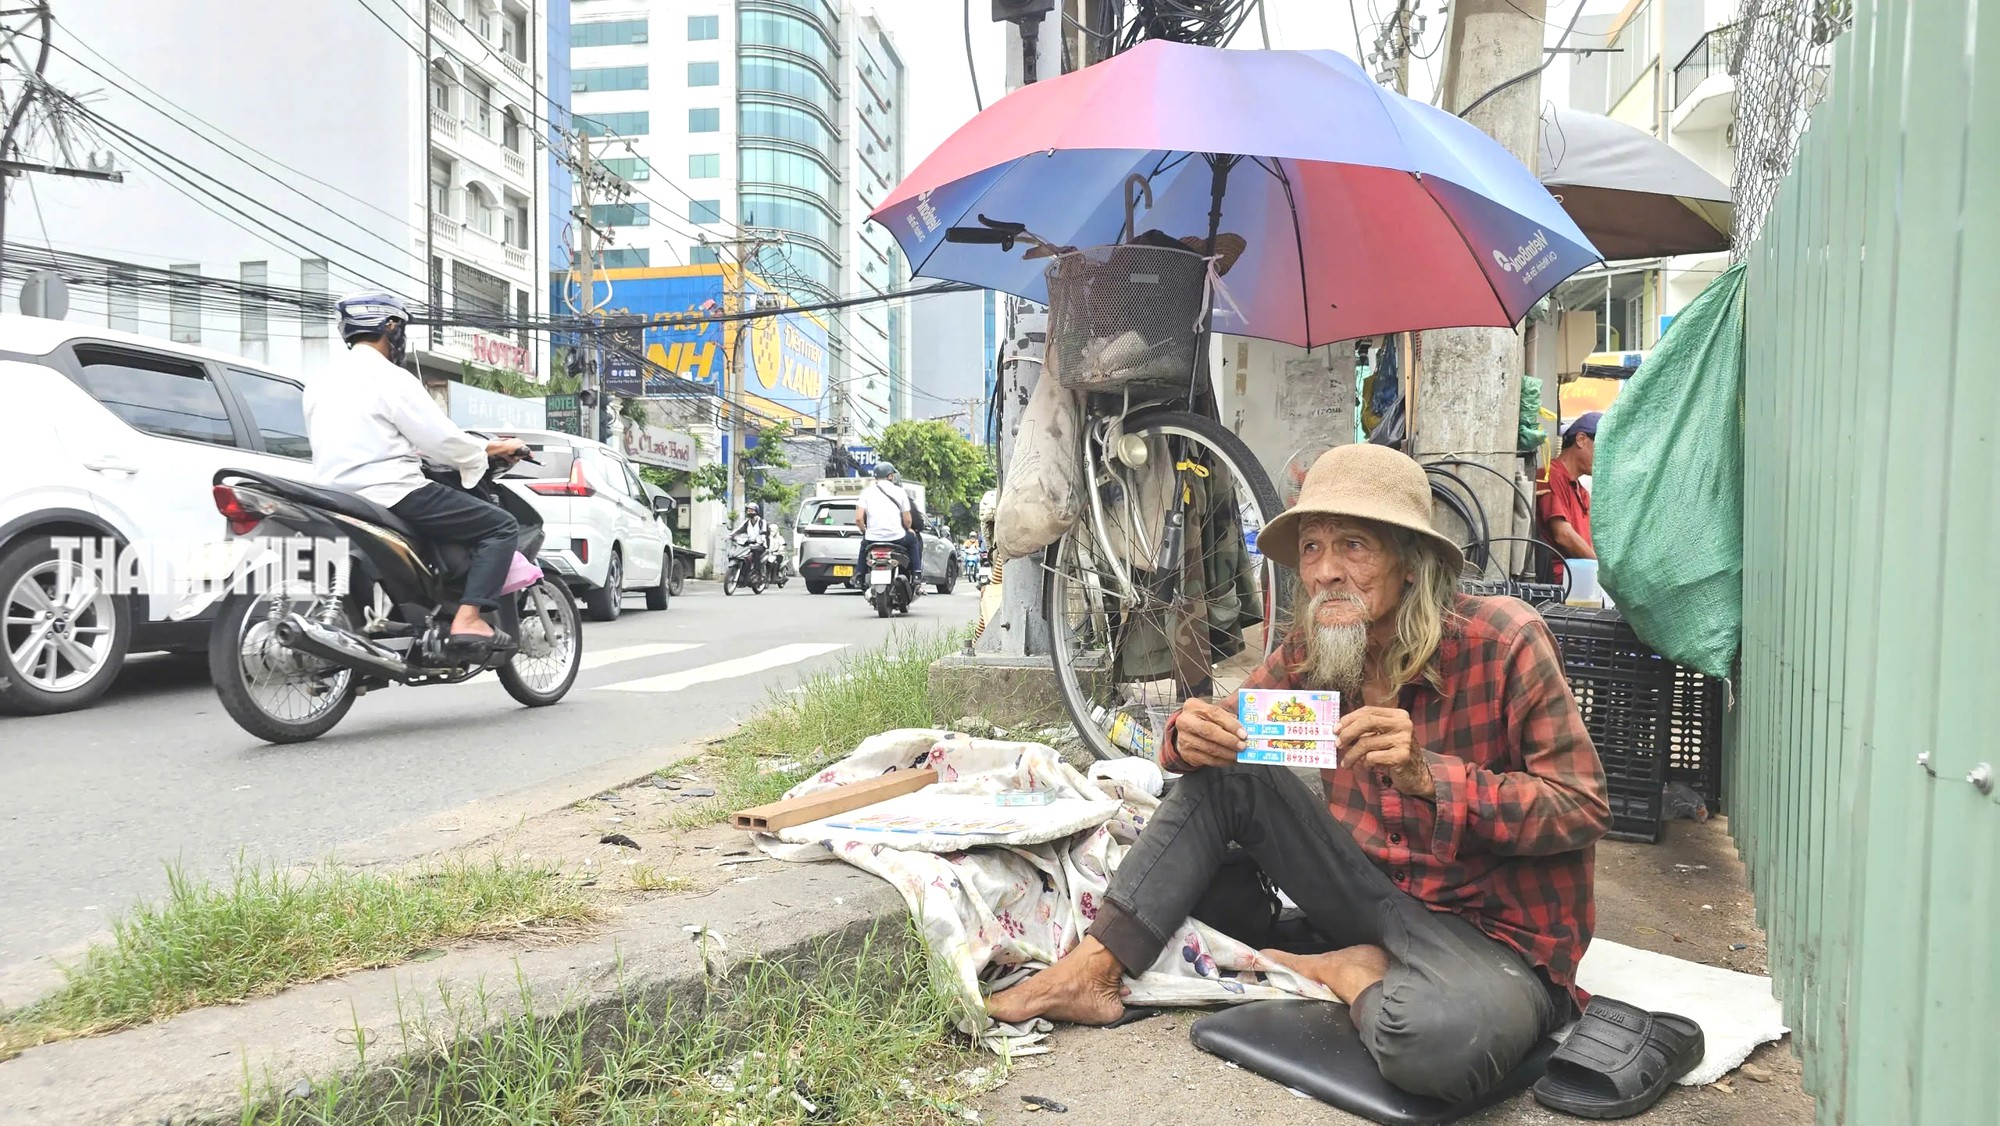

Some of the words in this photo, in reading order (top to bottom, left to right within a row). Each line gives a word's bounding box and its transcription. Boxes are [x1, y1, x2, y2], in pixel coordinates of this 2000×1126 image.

[473, 334, 534, 376] HOTEL
[645, 342, 716, 378] NH
[781, 355, 821, 400] XANH
[548, 397, 577, 410] HOTEL
